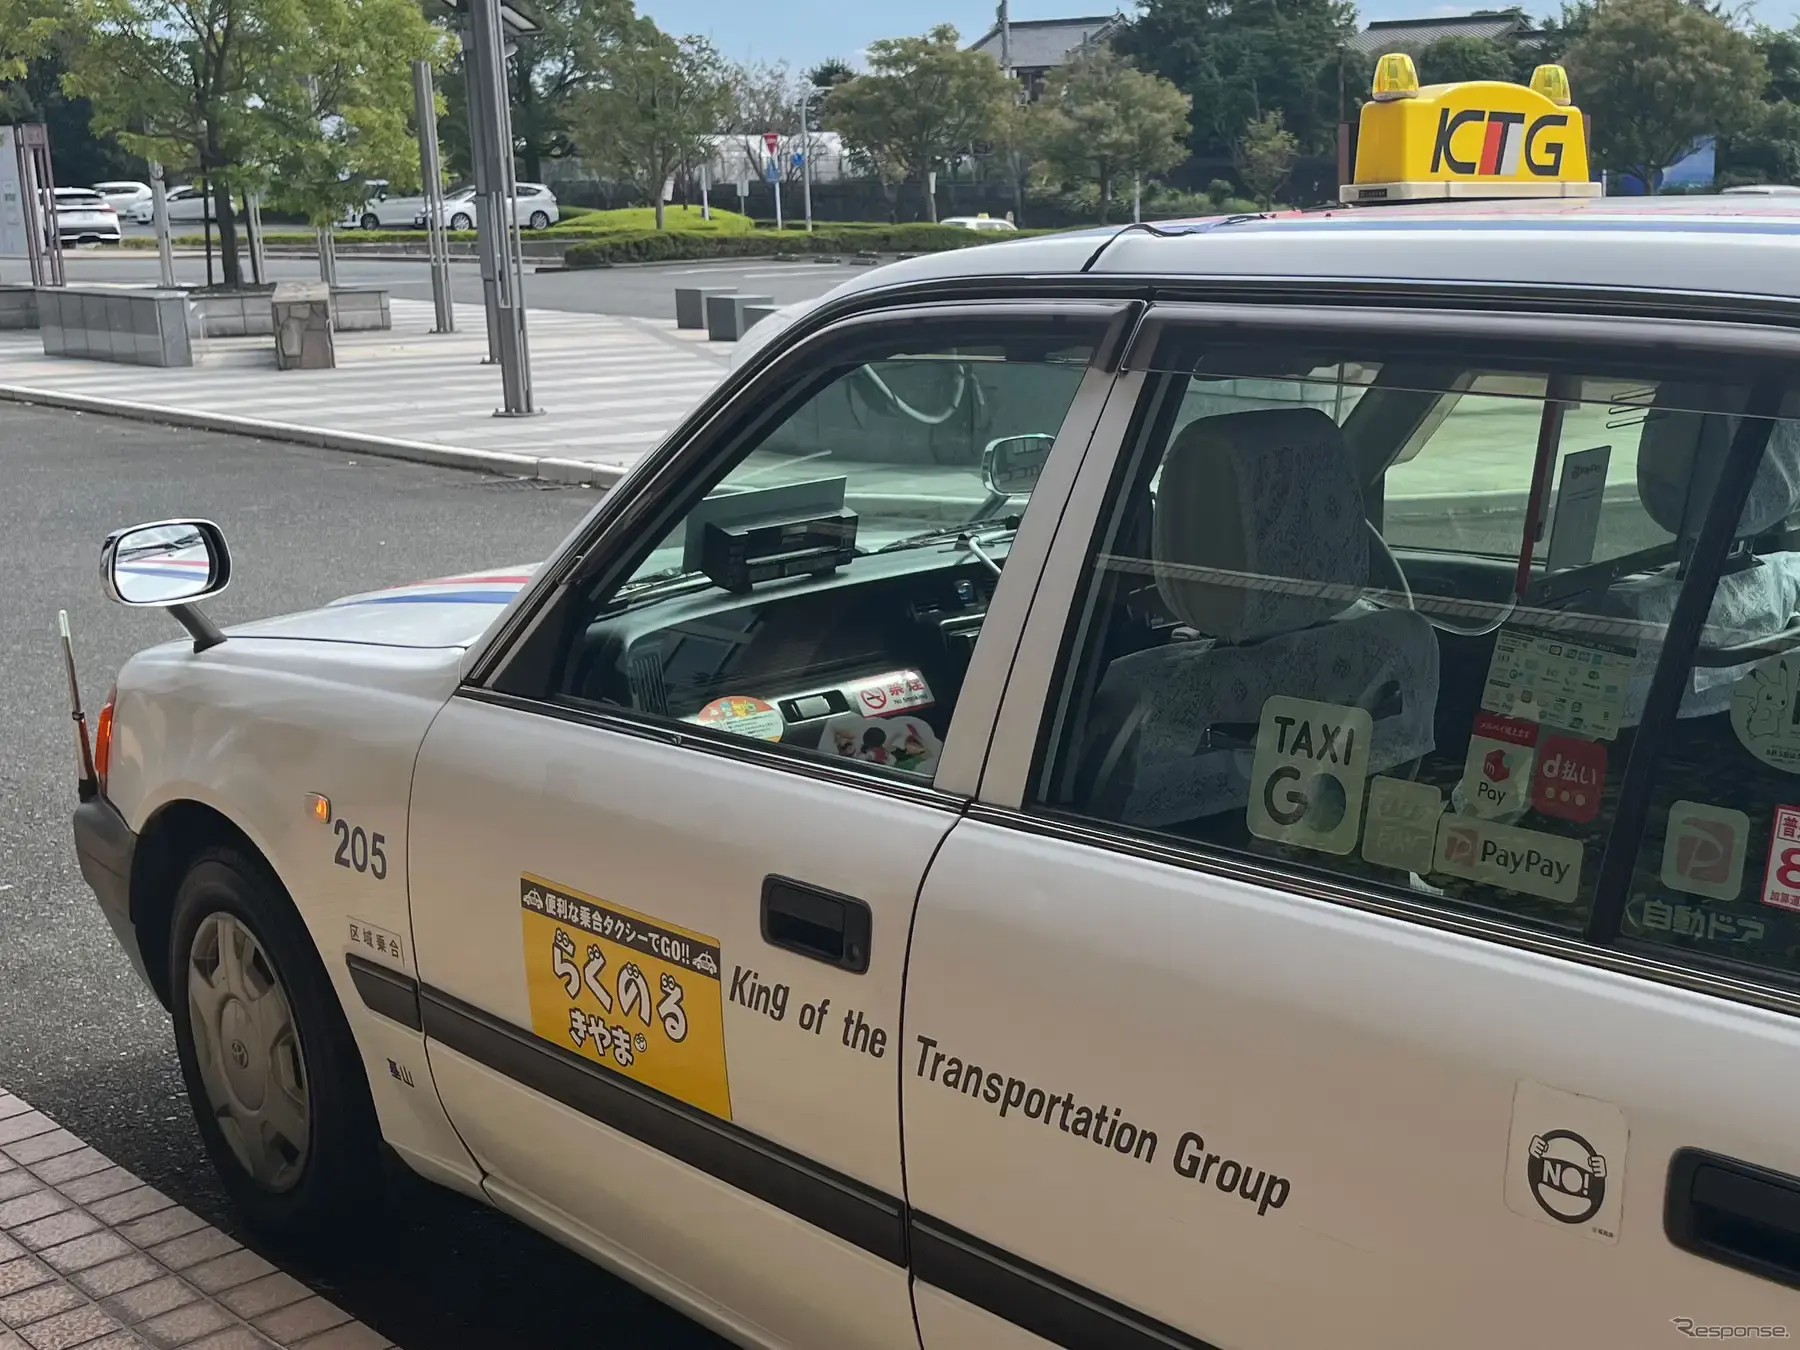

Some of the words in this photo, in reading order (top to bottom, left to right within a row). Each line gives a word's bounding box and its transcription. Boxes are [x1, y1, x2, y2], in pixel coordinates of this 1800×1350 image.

[1430, 107, 1568, 176] KTG
[1274, 715, 1355, 766] TAXI
[1542, 753, 1597, 786] d払い
[1263, 765, 1347, 834] GO
[1477, 780, 1507, 807] Pay
[334, 818, 387, 880] 205
[1480, 839, 1571, 885] PayPay
[545, 892, 690, 965] 便利な乗合タクシーでGO!!
[1642, 899, 1765, 942] 自動ドア
[552, 928, 687, 1043] らくのる
[569, 1008, 634, 1067] きやま
[729, 965, 790, 1022] King
[799, 999, 830, 1035] of
[843, 1010, 887, 1058] the
[917, 1035, 1158, 1163] Transportation
[1172, 1131, 1292, 1216] Group
[1542, 1159, 1590, 1196] NO!
